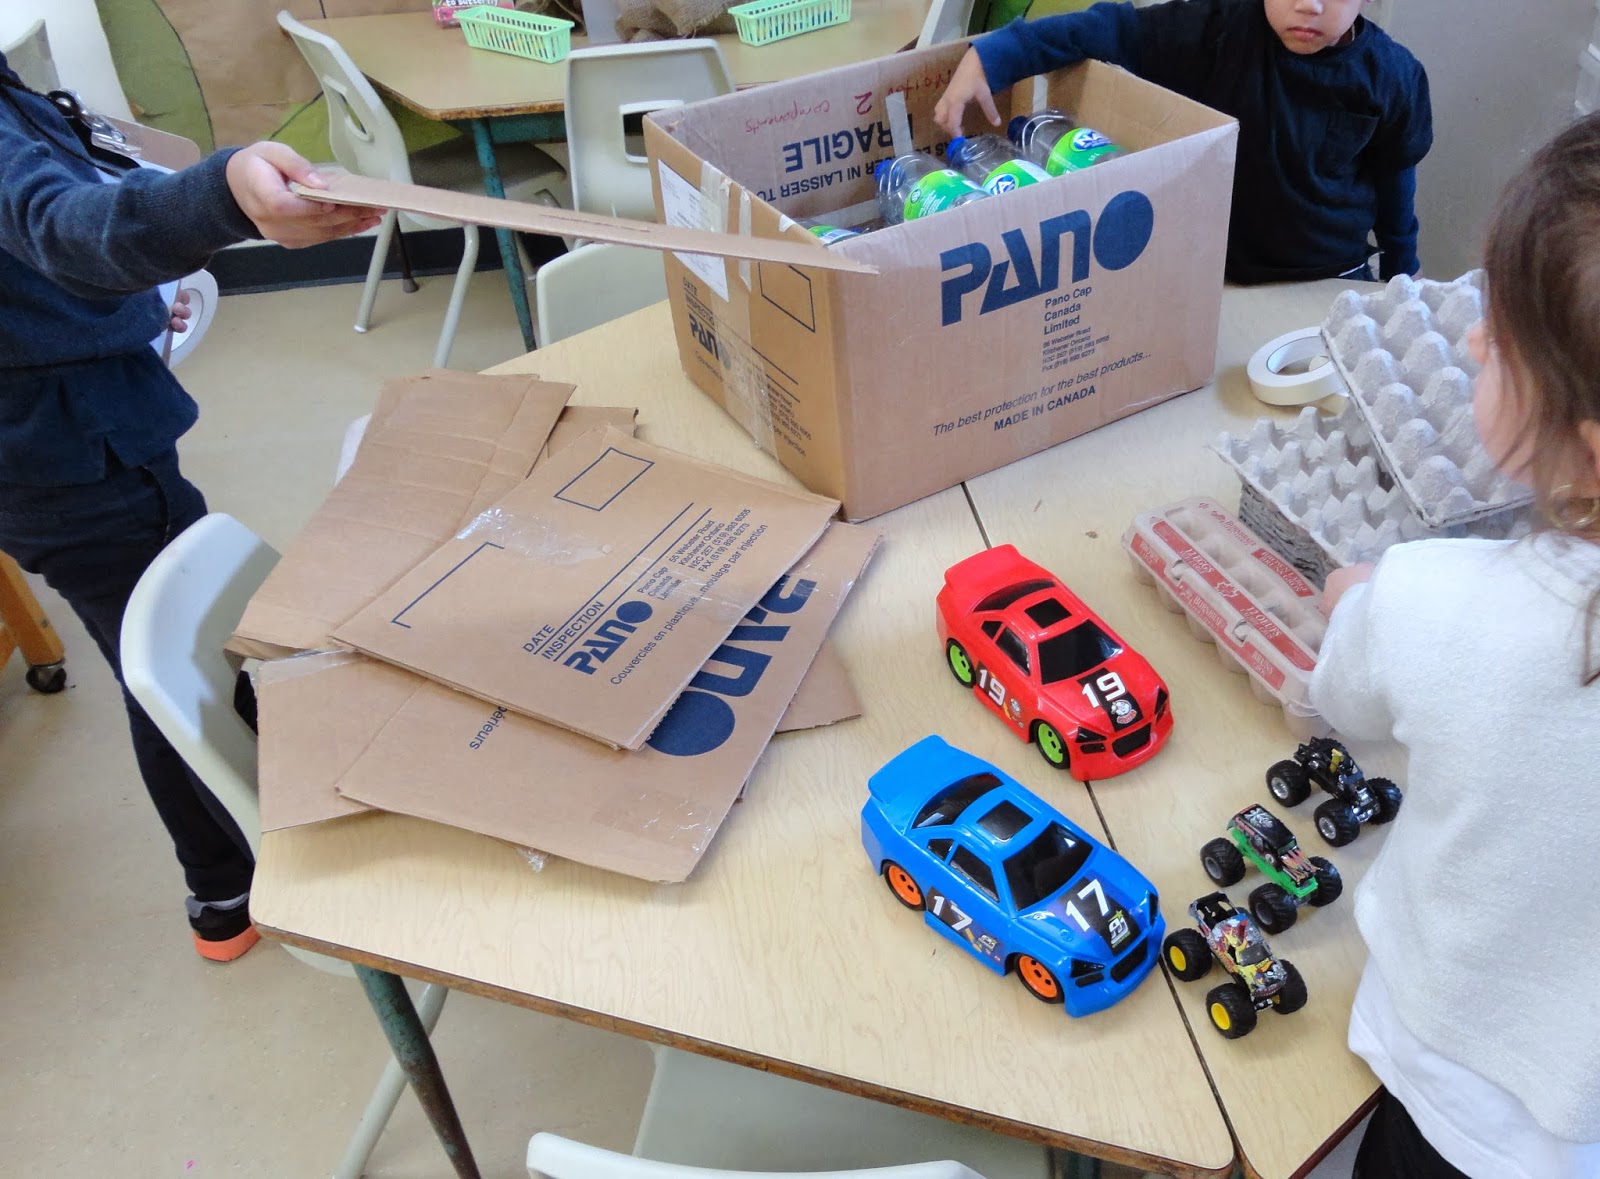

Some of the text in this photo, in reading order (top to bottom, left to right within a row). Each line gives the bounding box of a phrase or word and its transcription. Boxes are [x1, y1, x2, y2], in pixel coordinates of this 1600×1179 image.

[854, 92, 872, 115] 2
[781, 170, 842, 198] LAISSER
[848, 164, 861, 180] NI
[939, 190, 1154, 327] PANO
[1044, 302, 1080, 321] Canada
[1045, 286, 1092, 308] Pano Cap
[1044, 315, 1080, 335] Limited
[933, 420, 955, 436] The
[957, 410, 981, 428] best
[984, 391, 1037, 421] protection
[1040, 385, 1056, 397] for
[1057, 378, 1073, 391] the
[1076, 367, 1098, 384] best
[994, 385, 1095, 431] MADE IN CANADA
[669, 520, 715, 563] 55 Webster Road
[679, 523, 725, 566] Kitchener Ontario
[688, 555, 703, 569] N2C
[702, 544, 714, 557] 2E7
[712, 530, 729, 547] (519)
[698, 557, 713, 573] FAX
[711, 545, 726, 562] (519)
[637, 566, 668, 594] Pano Cap
[1192, 554, 1214, 575] EGGS
[610, 641, 657, 685] Couvercles
[655, 627, 669, 642] en
[730, 548, 742, 564] par
[741, 524, 768, 553] injection
[1247, 605, 1260, 618] 12
[523, 624, 555, 653] DATE
[541, 601, 605, 660] INSPECTION
[563, 601, 653, 675] PANO
[979, 670, 1006, 706] 19
[1082, 672, 1126, 708] 19
[932, 895, 972, 931] 17
[1065, 879, 1109, 932] 17
